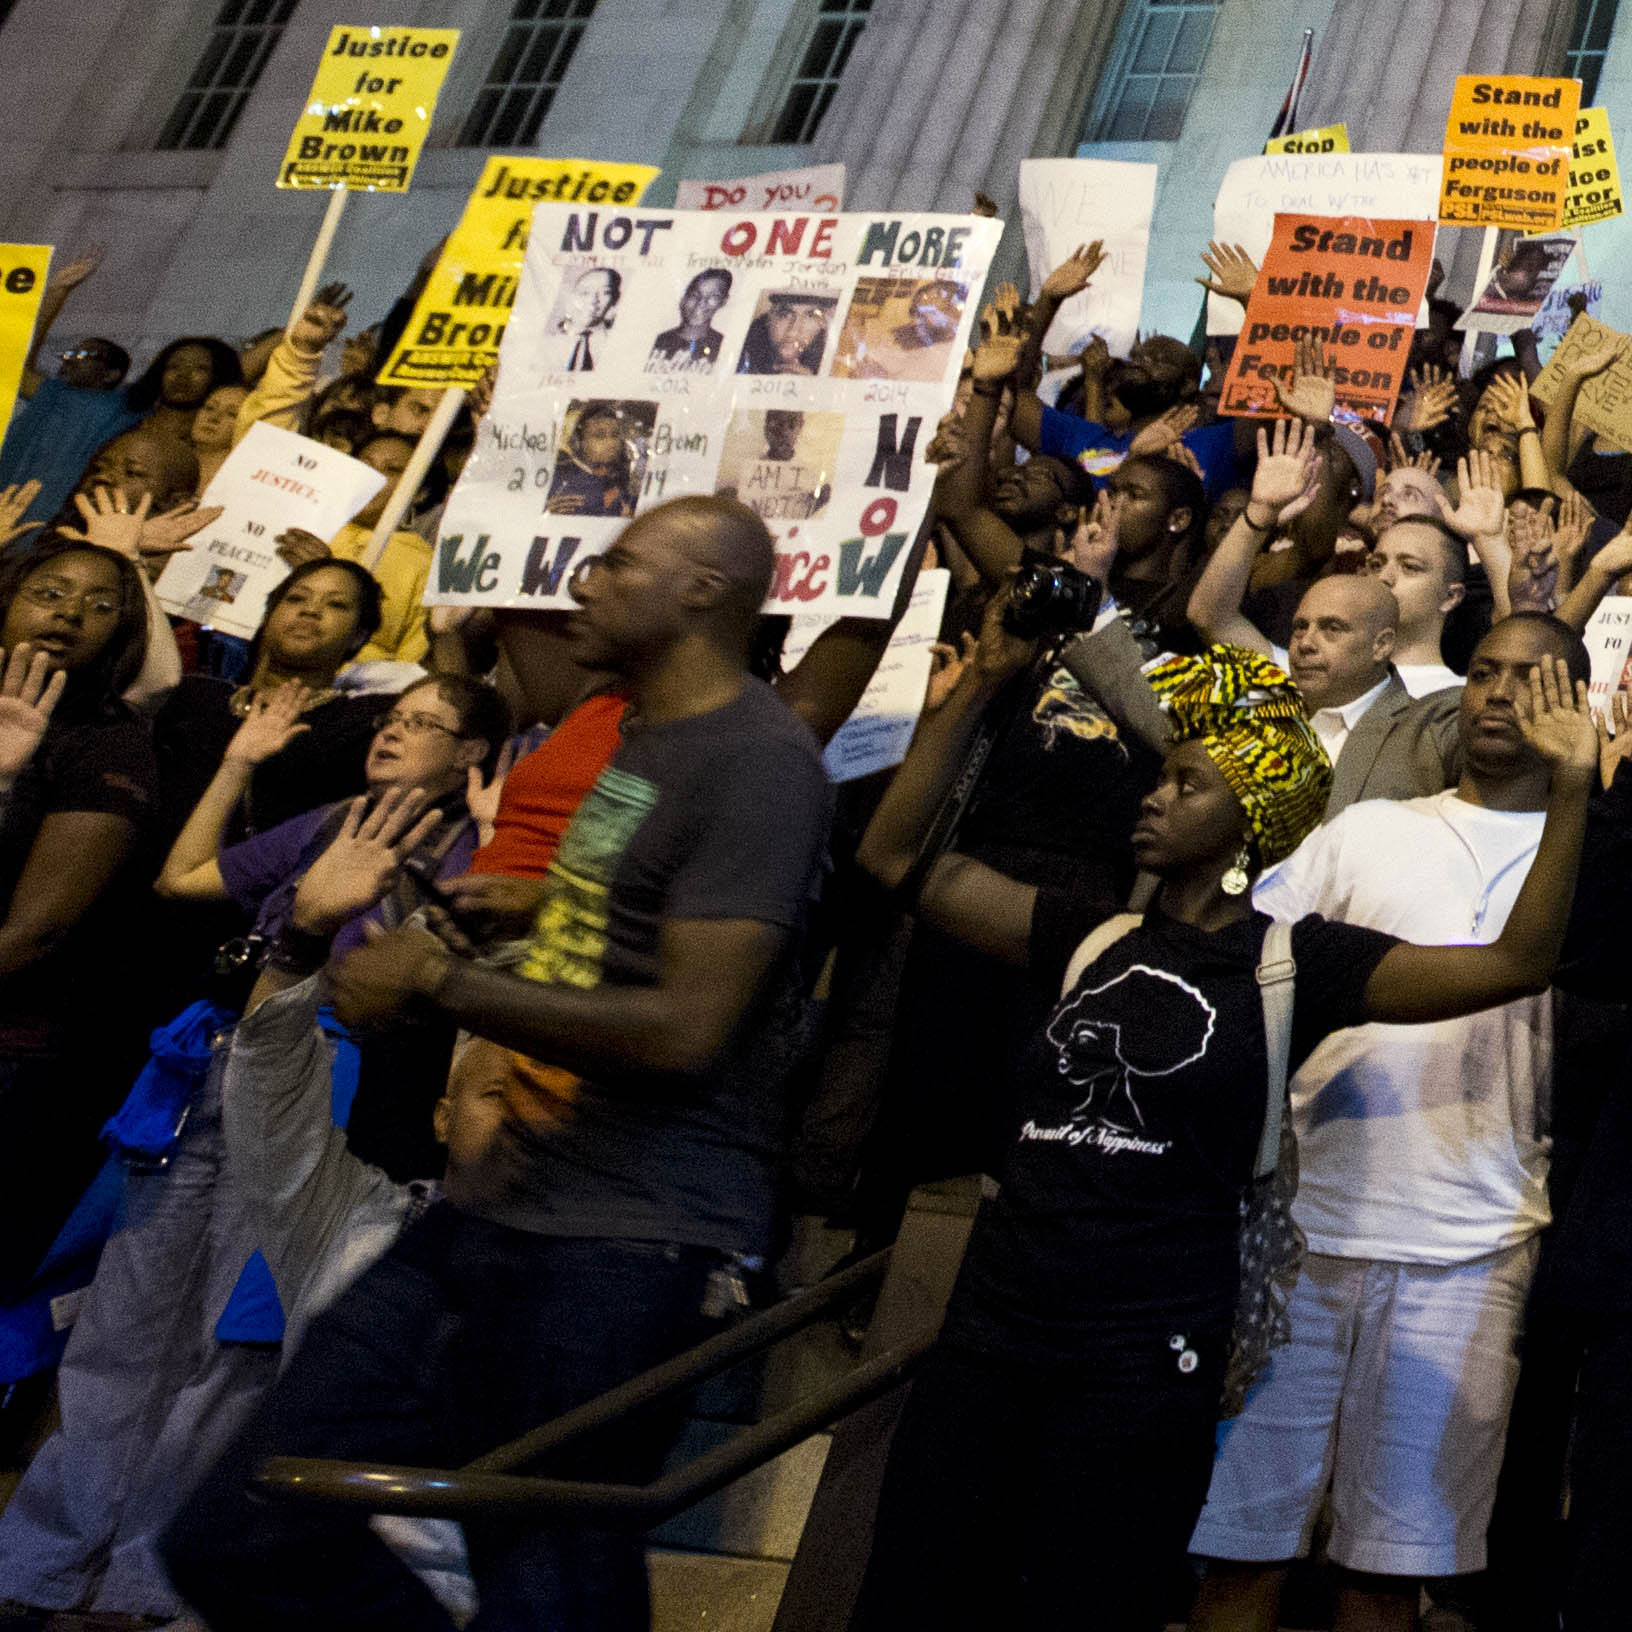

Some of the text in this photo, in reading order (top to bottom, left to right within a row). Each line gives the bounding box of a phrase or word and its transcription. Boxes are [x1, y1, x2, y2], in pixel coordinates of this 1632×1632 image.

[333, 34, 449, 58] Justice
[354, 71, 403, 94] for
[1472, 83, 1562, 108] Stand
[323, 108, 403, 134] Mike
[1459, 118, 1516, 137] with
[1522, 121, 1563, 140] the
[298, 135, 409, 162] Brown
[1450, 155, 1560, 176] people of
[485, 166, 637, 203] Justice
[1445, 179, 1556, 204] Ferguson
[561, 212, 972, 268] NOT ONE MORE
[1289, 223, 1413, 262] Stand
[453, 272, 518, 307] Mi
[1267, 271, 1411, 305] with the
[417, 311, 507, 347] Bro
[1367, 325, 1405, 352] of
[1237, 354, 1393, 391] Ferson
[751, 380, 800, 397] 2012
[863, 383, 909, 403] 2014
[491, 421, 558, 454] Michael
[290, 453, 319, 471] NO
[242, 520, 267, 537] NO
[438, 533, 502, 594] We
[1597, 612, 1632, 625] JUST
[1604, 637, 1623, 650] FO
